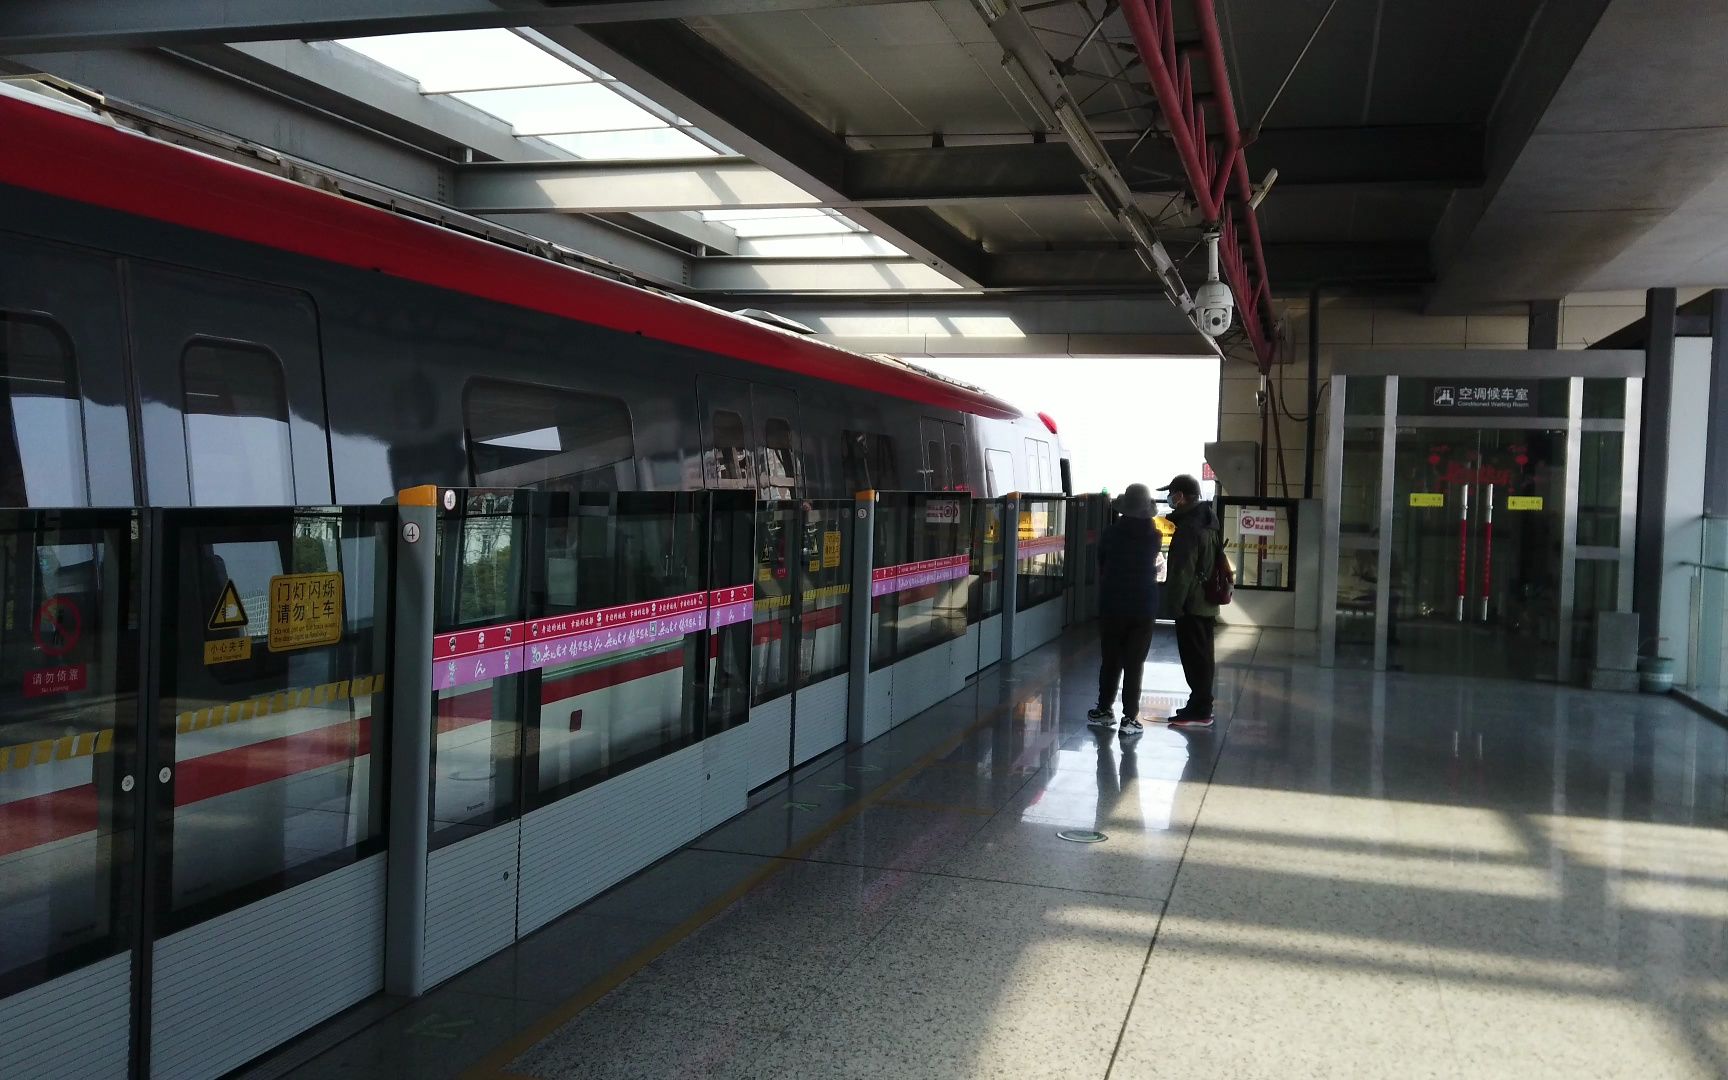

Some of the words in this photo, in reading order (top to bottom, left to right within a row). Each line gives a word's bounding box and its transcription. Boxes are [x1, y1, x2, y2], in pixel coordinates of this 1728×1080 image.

[1459, 387, 1529, 401] 空调候车室
[406, 526, 416, 540] 4
[277, 579, 335, 603] 门灯闪烁
[276, 600, 335, 624] 请勿上车
[32, 668, 79, 685] 请勿倚靠
